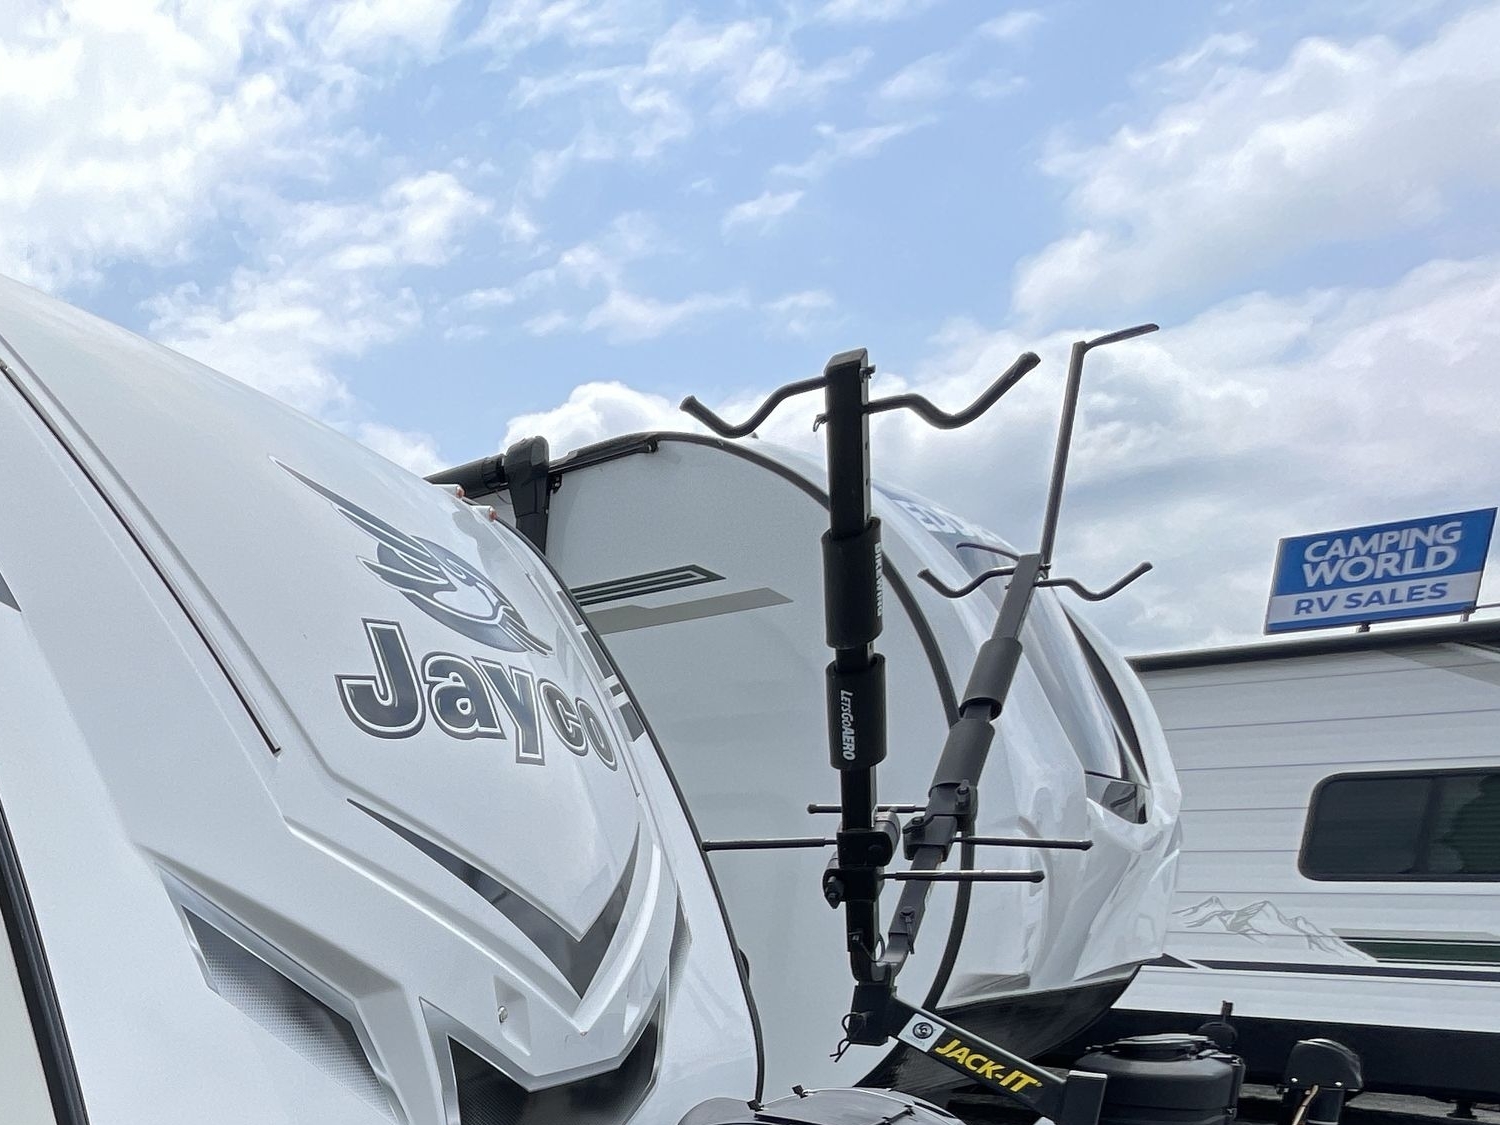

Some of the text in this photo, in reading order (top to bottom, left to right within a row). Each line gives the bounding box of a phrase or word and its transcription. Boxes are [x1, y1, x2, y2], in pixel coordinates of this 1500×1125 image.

[1304, 521, 1462, 562] CAMPING
[1303, 546, 1457, 587] WORLD
[1294, 582, 1449, 615] RV SALES
[334, 617, 617, 772] Jayco
